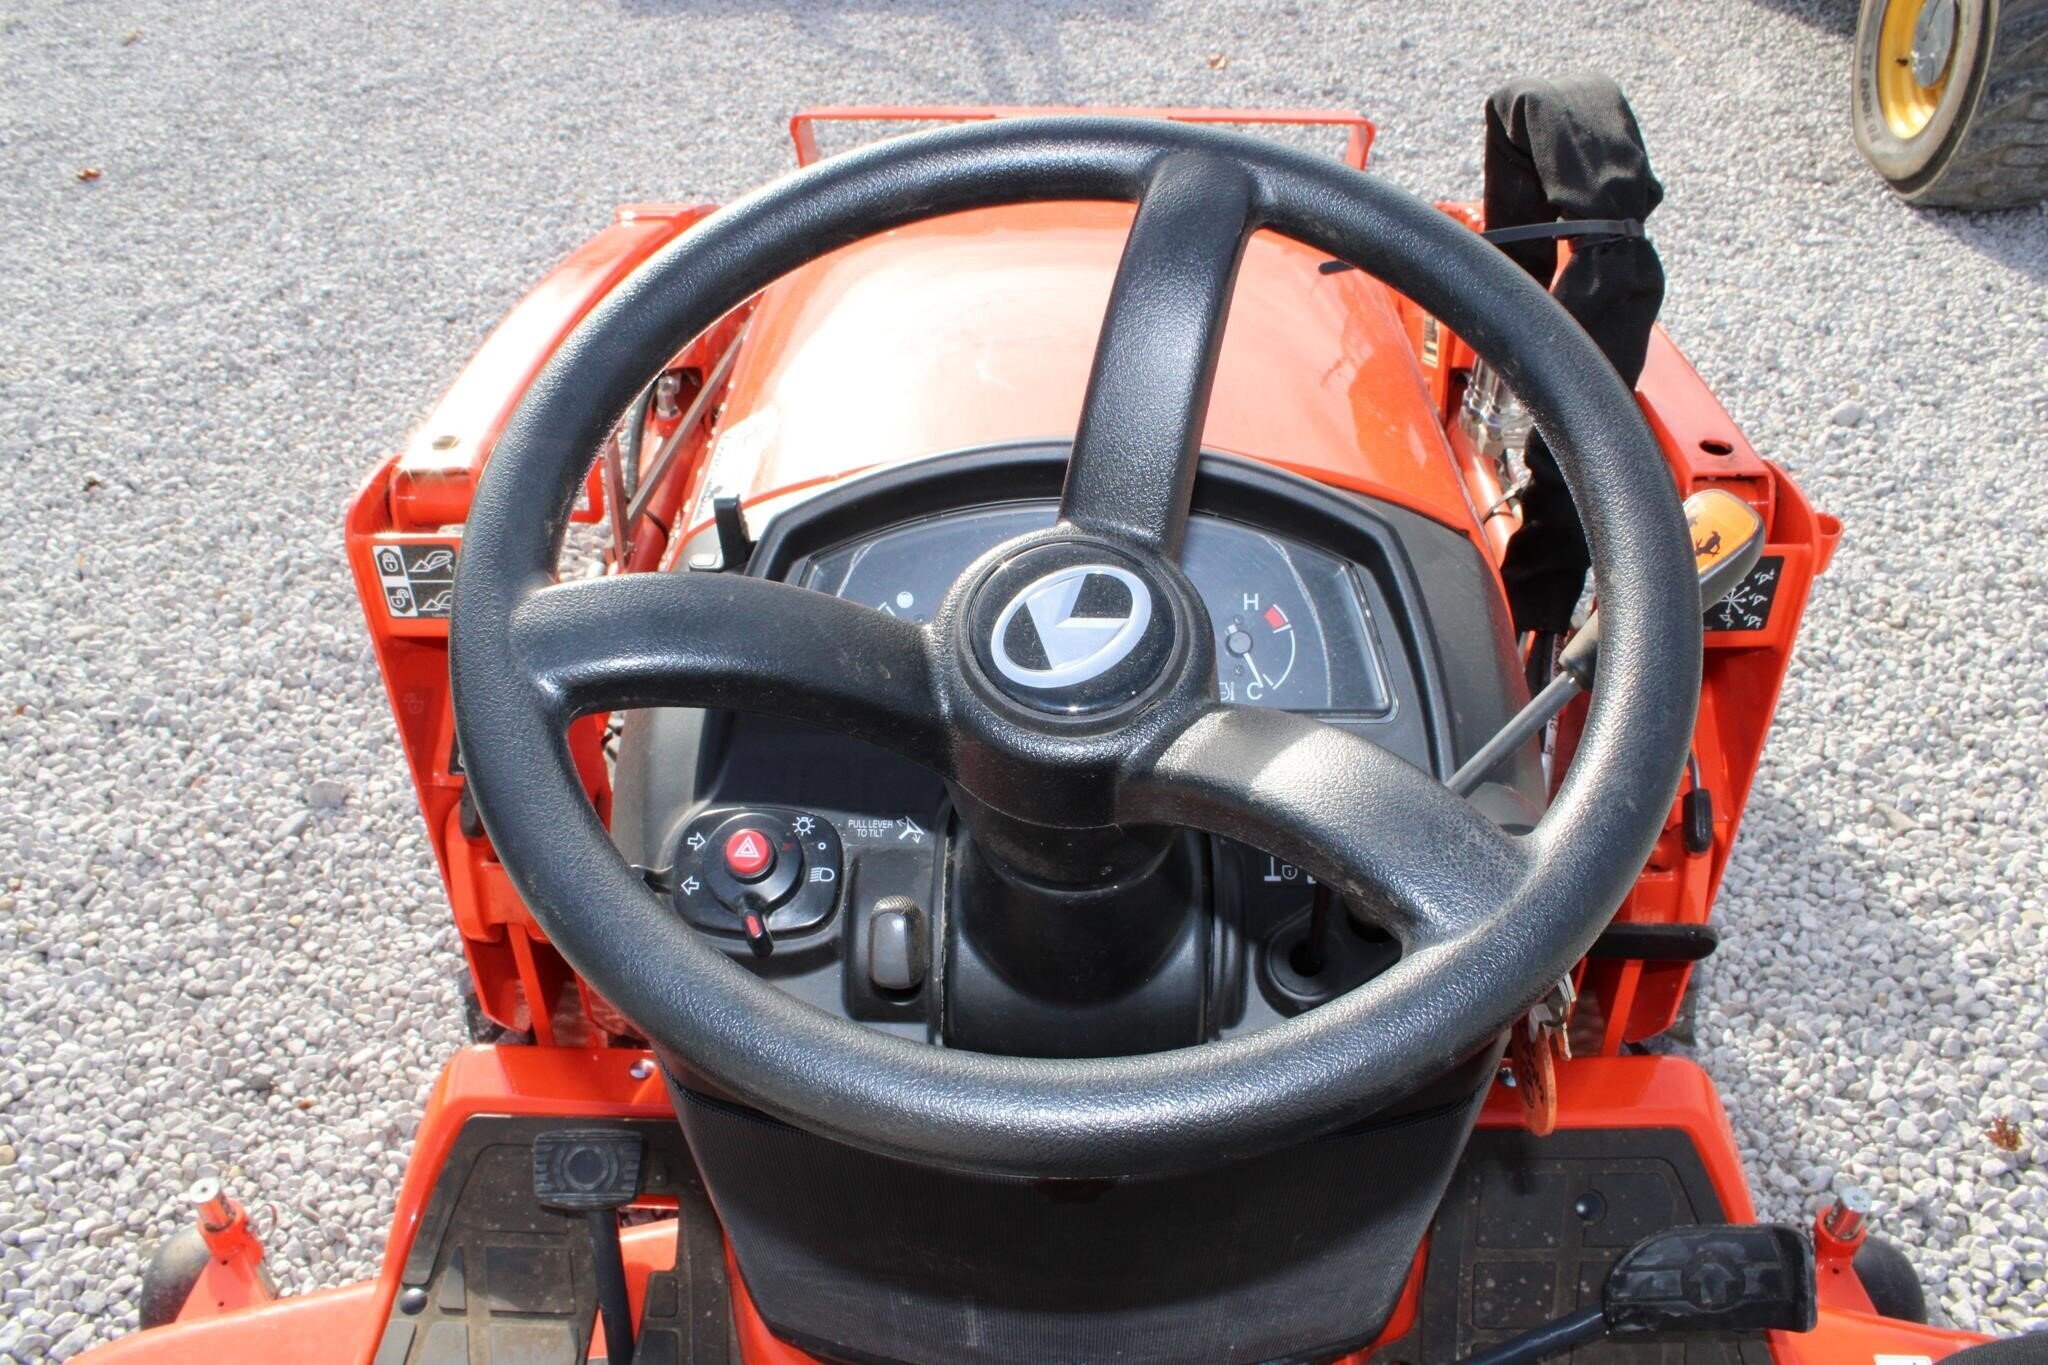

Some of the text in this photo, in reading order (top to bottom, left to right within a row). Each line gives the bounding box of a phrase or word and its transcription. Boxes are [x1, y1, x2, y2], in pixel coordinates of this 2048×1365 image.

[1243, 593, 1259, 611] H
[1246, 682, 1263, 700] C
[848, 819, 894, 829] PULL LEVER
[856, 828, 884, 838] TO TILT
